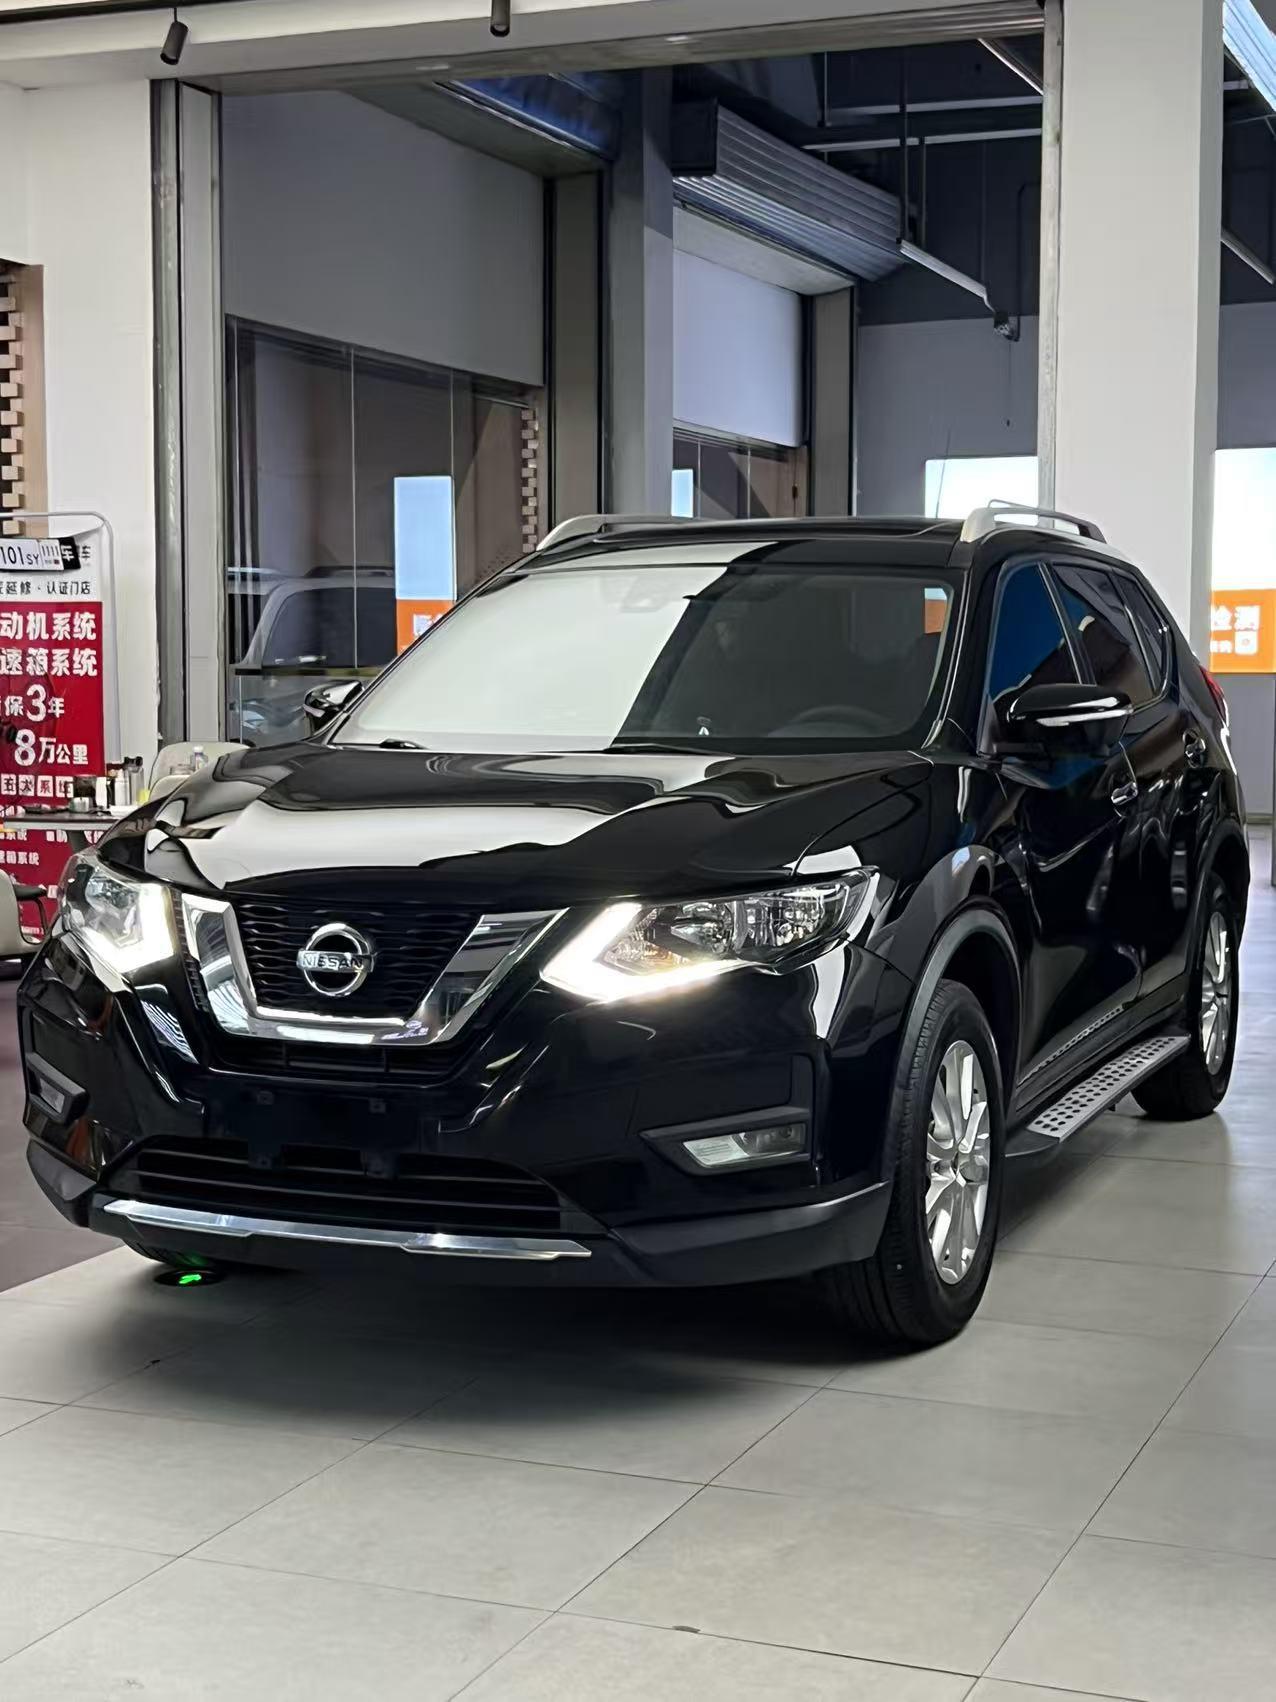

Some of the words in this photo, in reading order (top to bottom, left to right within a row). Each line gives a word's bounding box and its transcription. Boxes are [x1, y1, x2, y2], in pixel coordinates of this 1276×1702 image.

[0, 611, 97, 640] 动机系统
[0, 647, 97, 676] 速箱系统
[0, 684, 65, 721] 保3年
[15, 729, 89, 766] 8万公里
[302, 953, 364, 970] NISSAN
